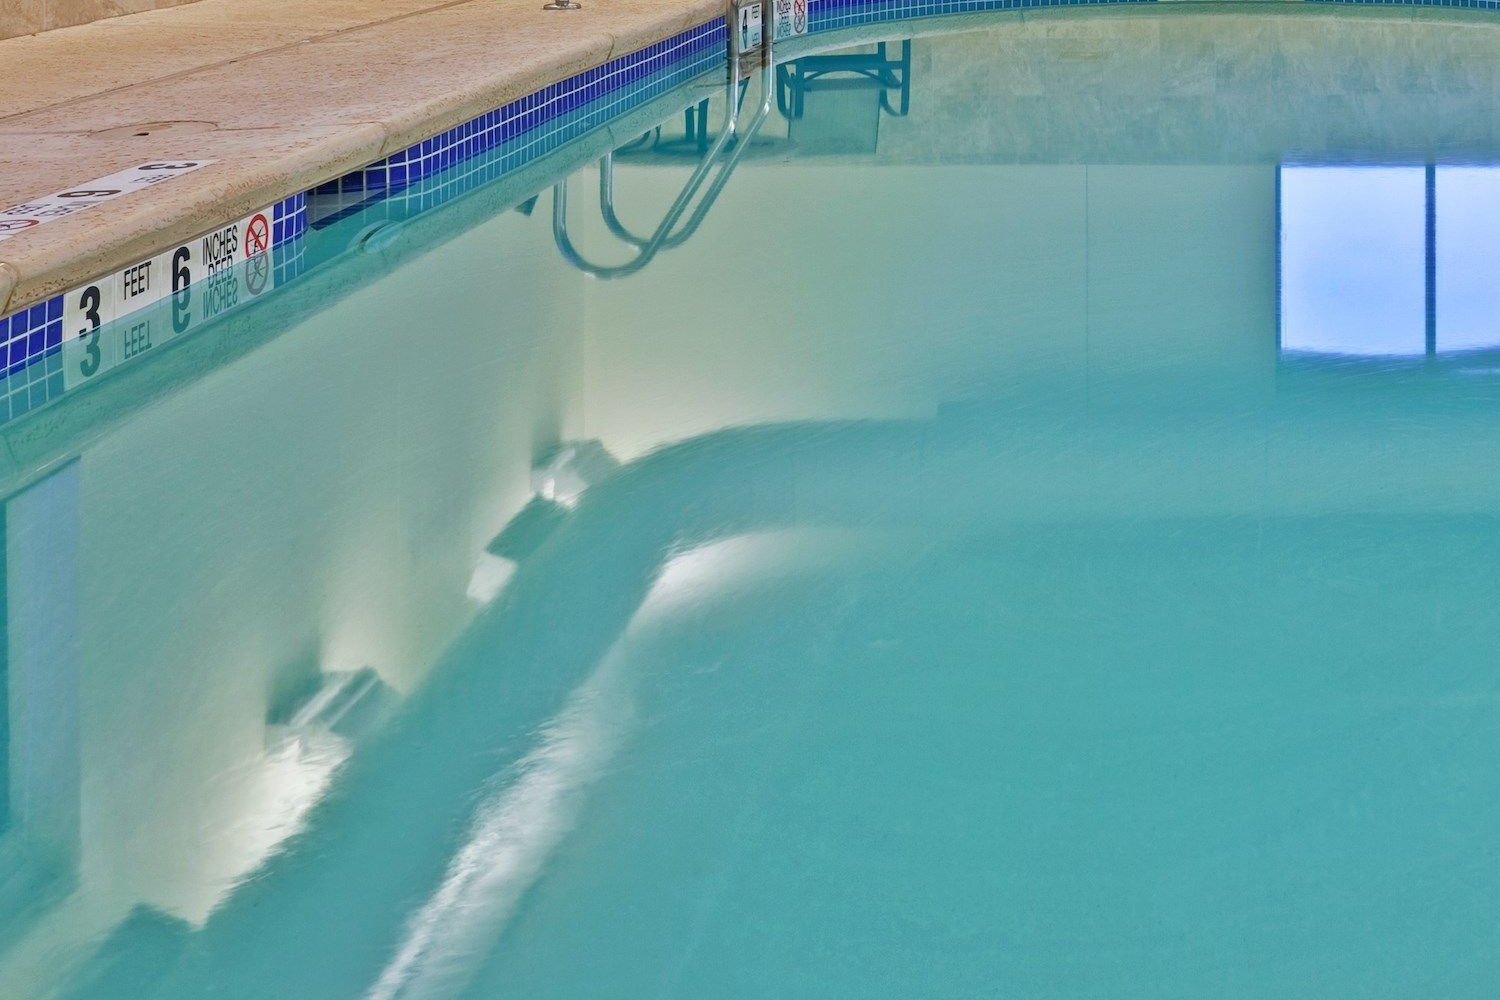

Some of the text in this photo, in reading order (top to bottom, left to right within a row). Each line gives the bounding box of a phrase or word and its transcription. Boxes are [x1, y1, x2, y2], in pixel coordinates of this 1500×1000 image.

[124, 260, 152, 300] FEET
[172, 246, 190, 294] 6
[202, 225, 238, 266] INCHES
